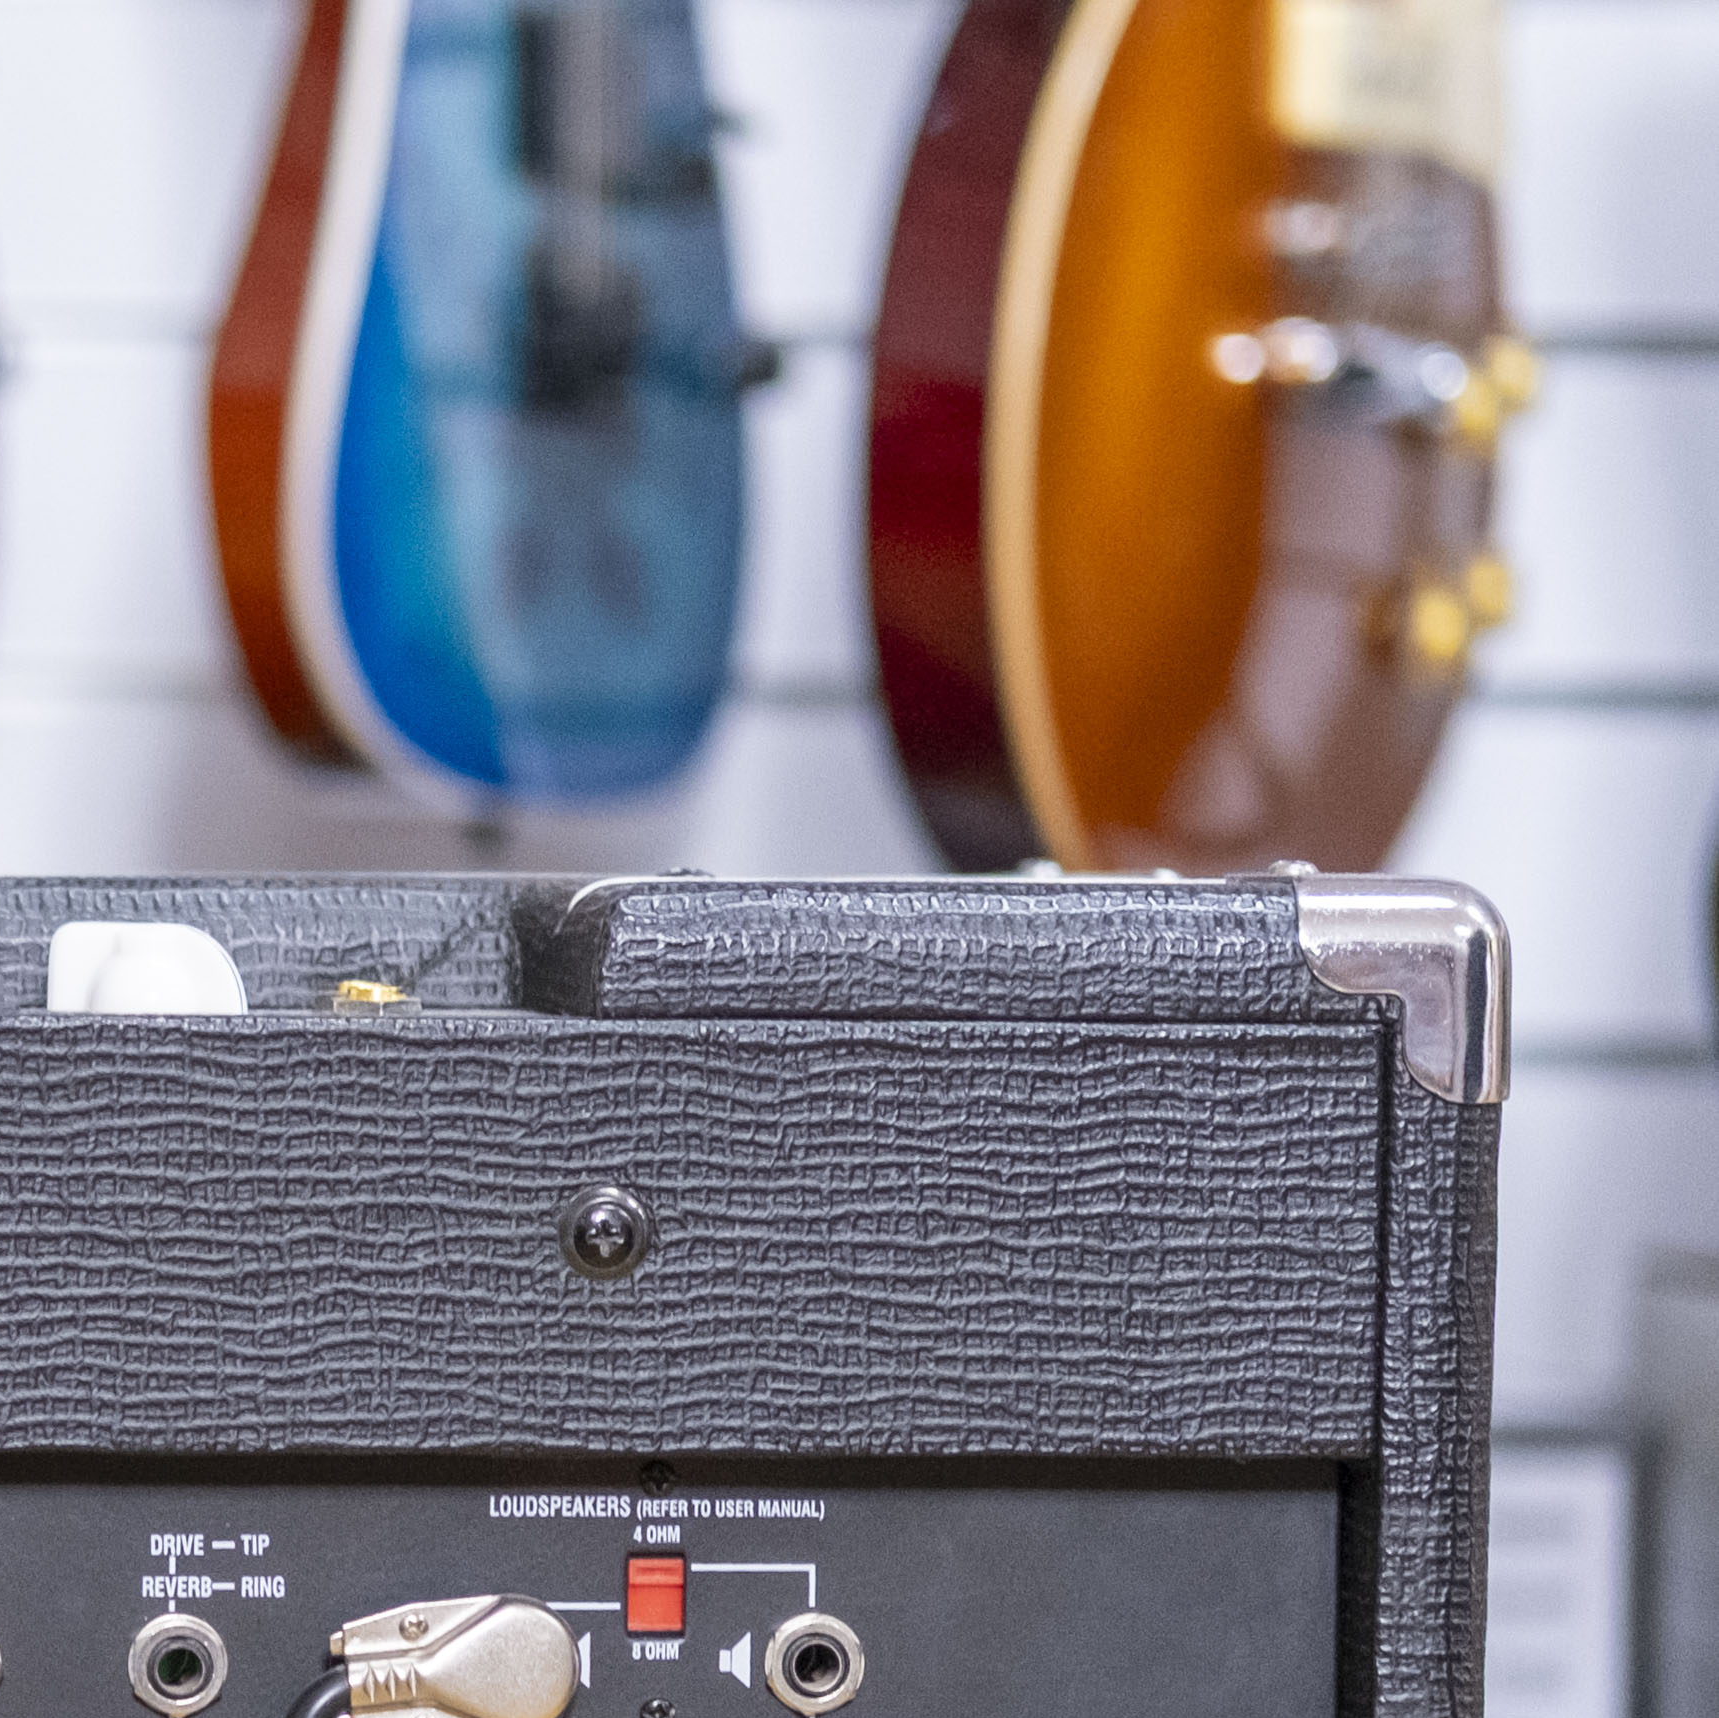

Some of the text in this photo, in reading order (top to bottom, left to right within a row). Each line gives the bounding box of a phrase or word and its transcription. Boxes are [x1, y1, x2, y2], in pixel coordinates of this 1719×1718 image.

[489, 1496, 826, 1522] LOUDSPEAKERS (REFER TO USER MANUAL)
[150, 1534, 270, 1557] DRIVE TIP
[633, 1525, 681, 1544] 4 OHM
[142, 1576, 285, 1599] REVERB RING
[632, 1641, 679, 1661] 8 OHM
